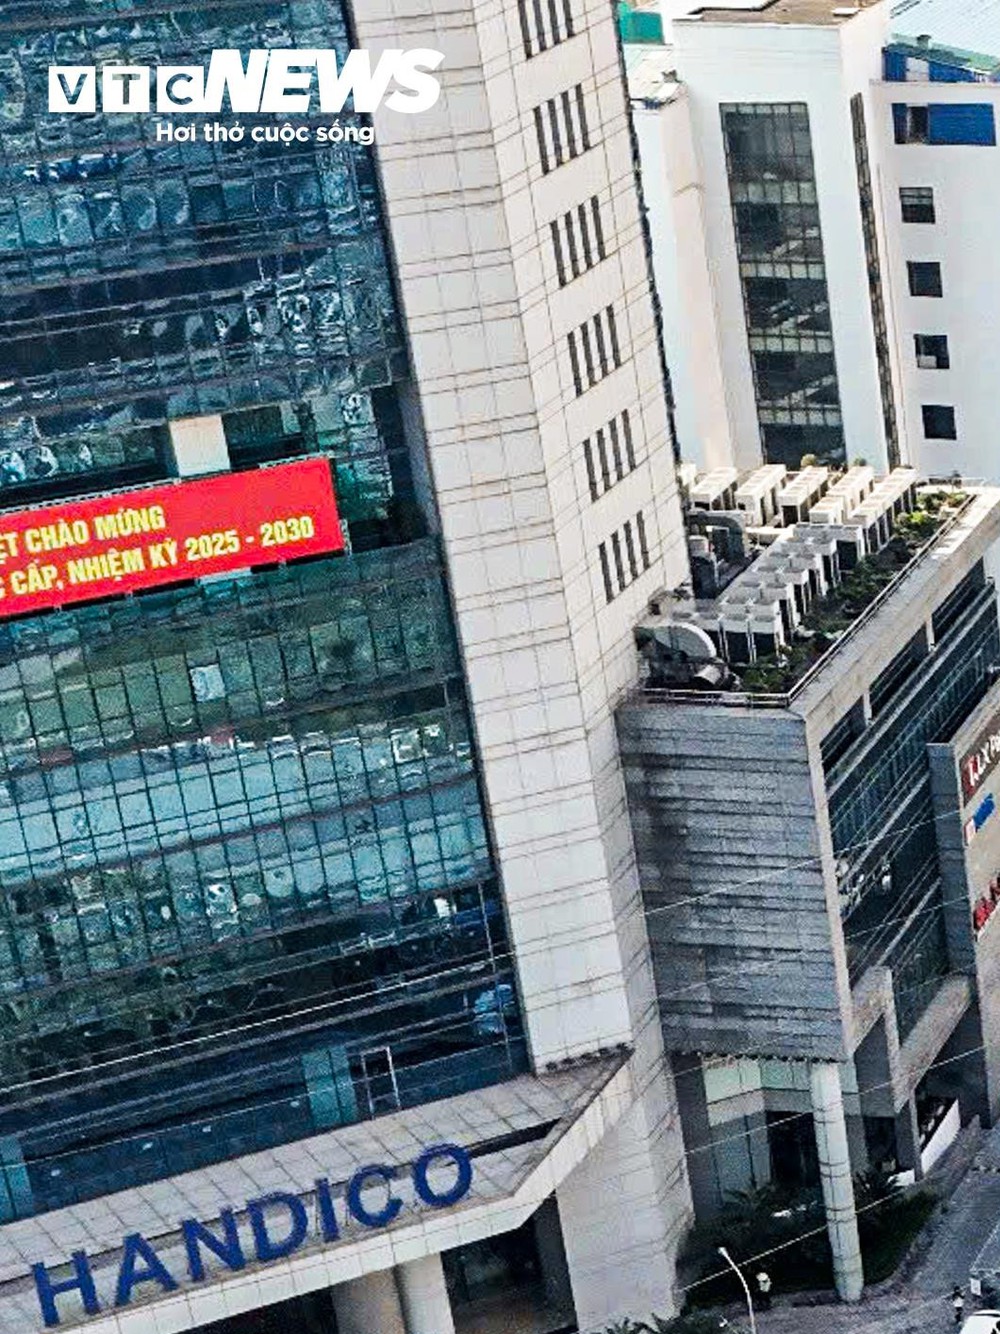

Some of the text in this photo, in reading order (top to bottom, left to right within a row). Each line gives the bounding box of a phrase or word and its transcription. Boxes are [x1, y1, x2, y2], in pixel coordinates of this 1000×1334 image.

[24, 517, 89, 553] CHÀO
[93, 505, 166, 541] MỪNG
[67, 547, 146, 585] NHIỆM
[148, 537, 177, 569] KỲ
[185, 529, 241, 562] 2025
[260, 515, 315, 548] 2030
[32, 1142, 473, 1327] HANDICO
